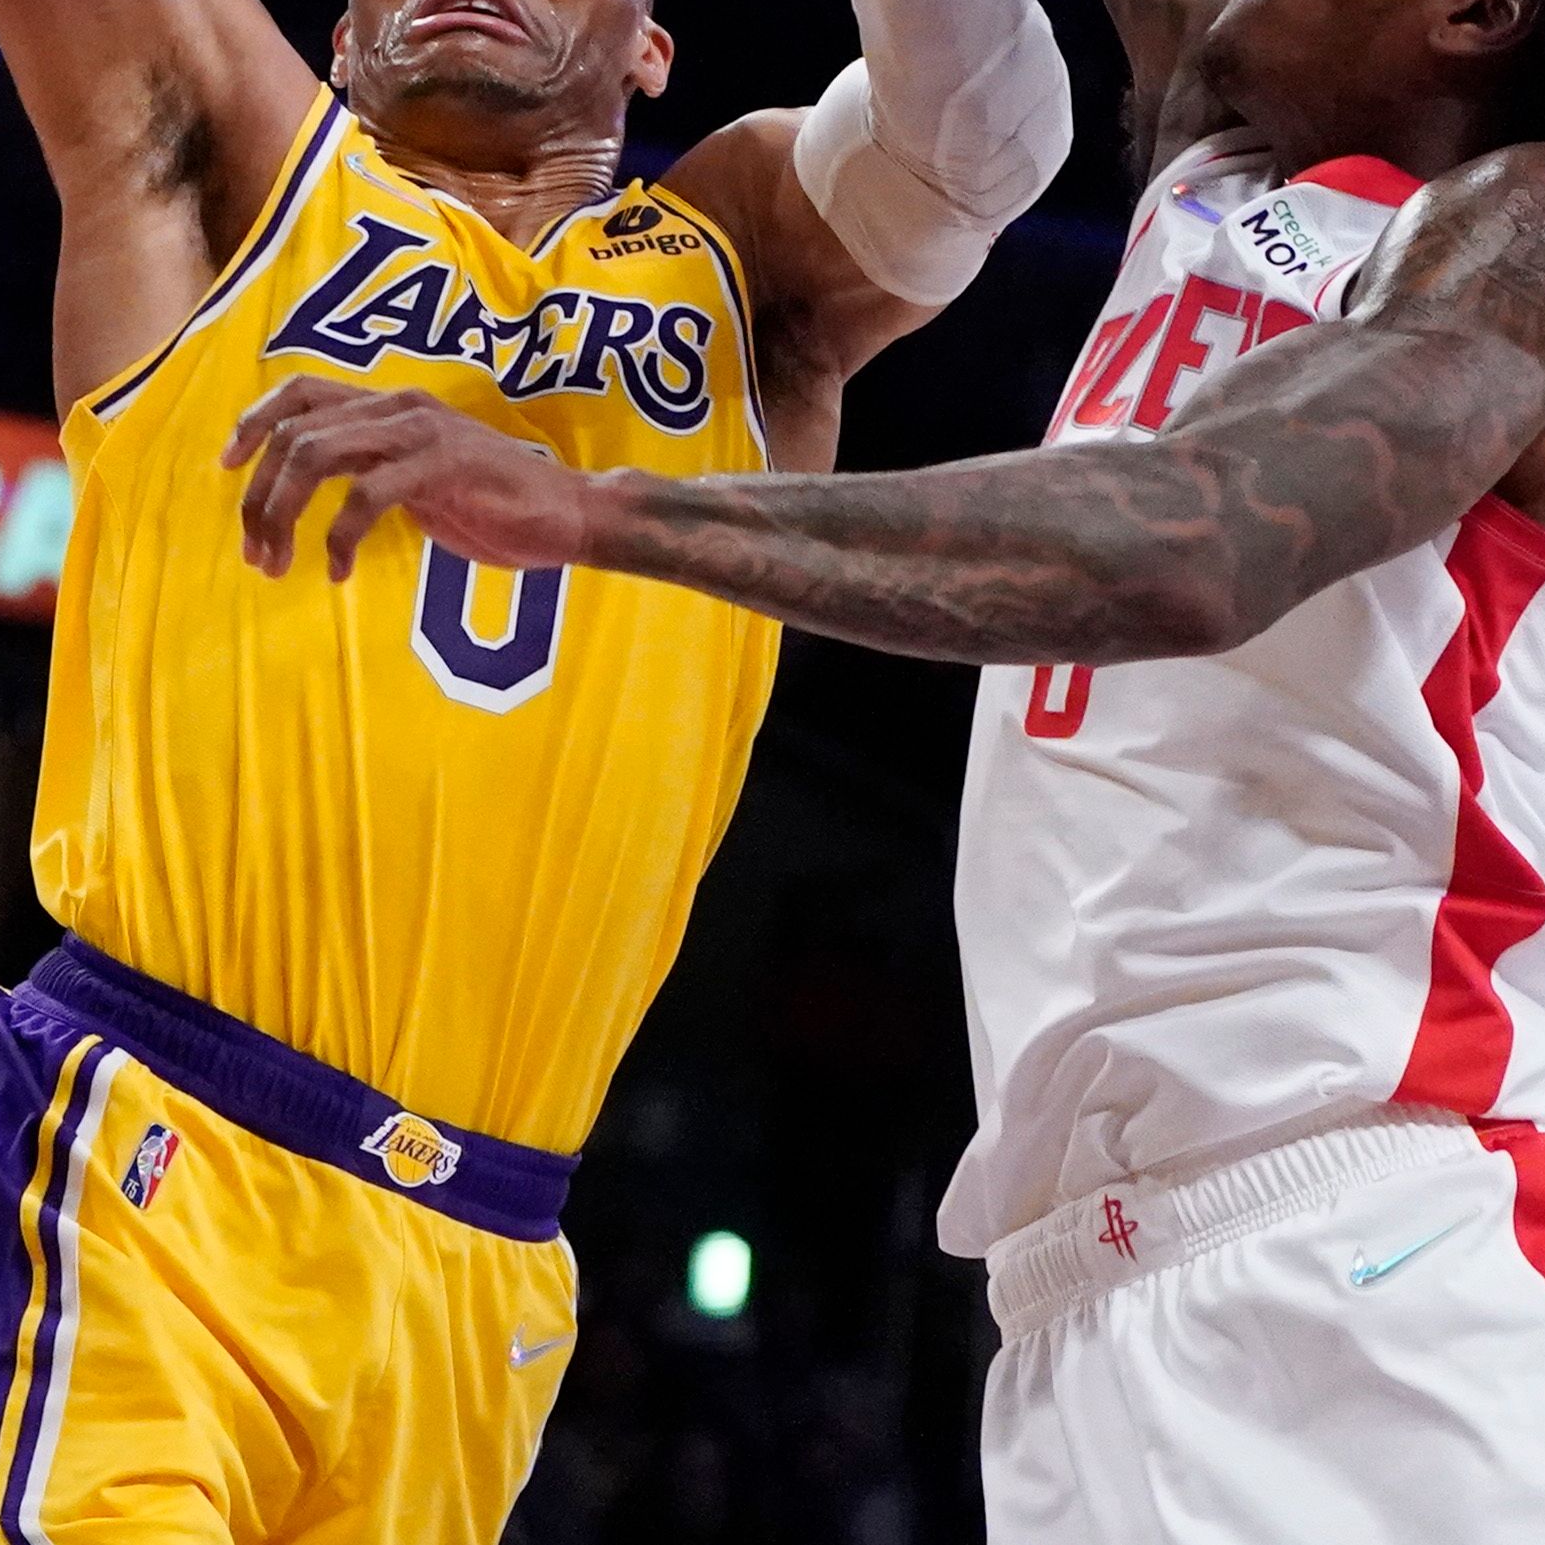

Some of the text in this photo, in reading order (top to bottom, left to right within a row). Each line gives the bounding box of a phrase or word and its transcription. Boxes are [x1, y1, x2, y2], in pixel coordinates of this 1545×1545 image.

[588, 234, 701, 261] bibigo
[258, 209, 716, 437] LAKERS
[362, 1120, 456, 1183] LAKERS
[124, 1177, 140, 1200] 75
